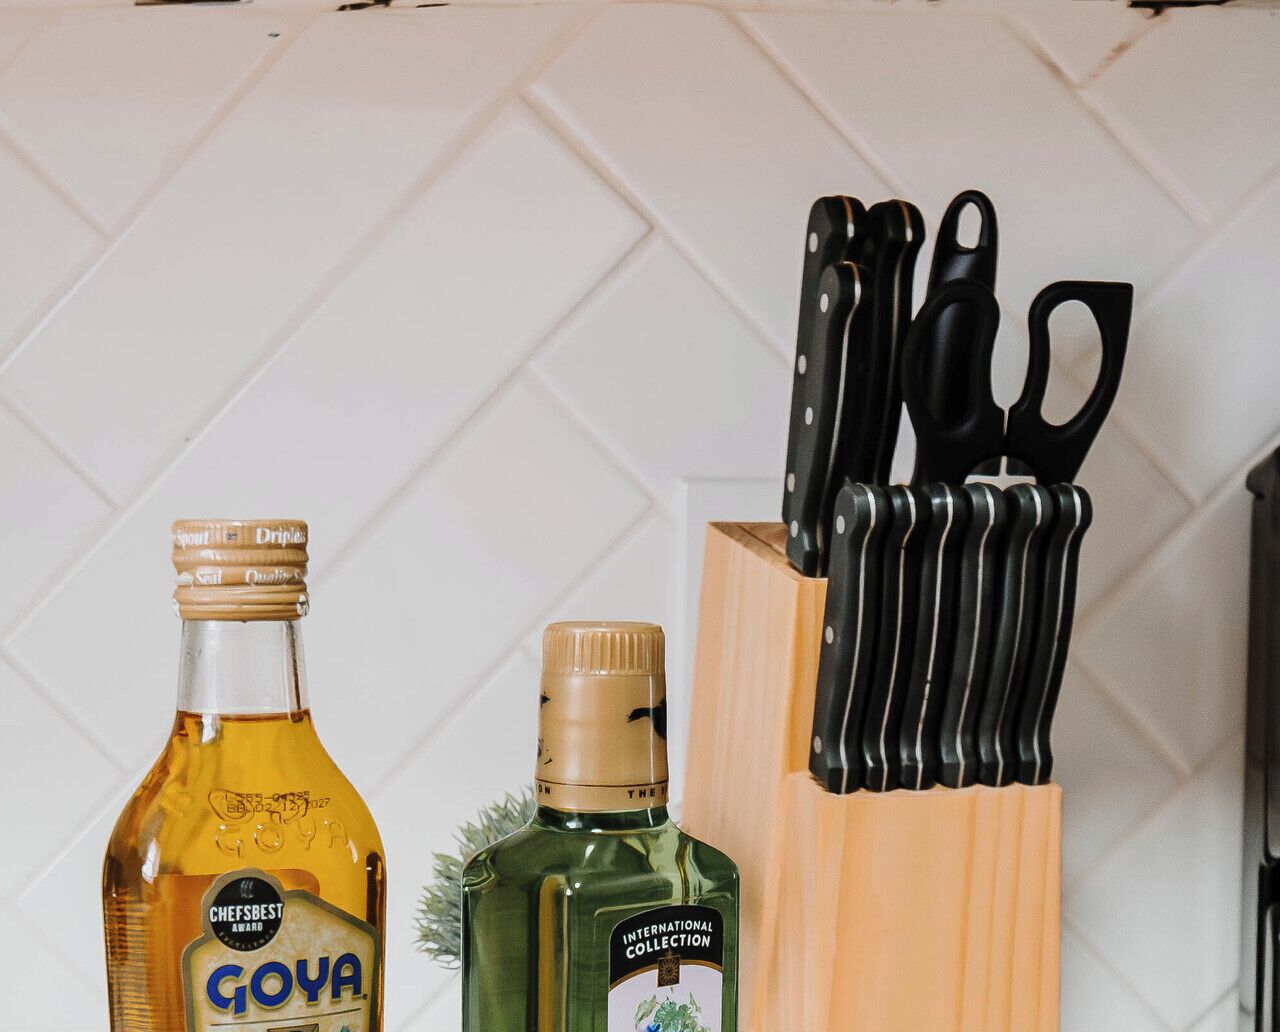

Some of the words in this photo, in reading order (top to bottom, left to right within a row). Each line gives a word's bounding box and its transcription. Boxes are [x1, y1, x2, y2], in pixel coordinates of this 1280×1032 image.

[627, 787, 656, 799] THE
[209, 902, 284, 923] CHEFSBEST
[231, 922, 264, 933] AWARD
[622, 919, 713, 945] INTERNATIONAL
[625, 933, 711, 959] COLLECTION
[206, 952, 362, 1015] GOYA
